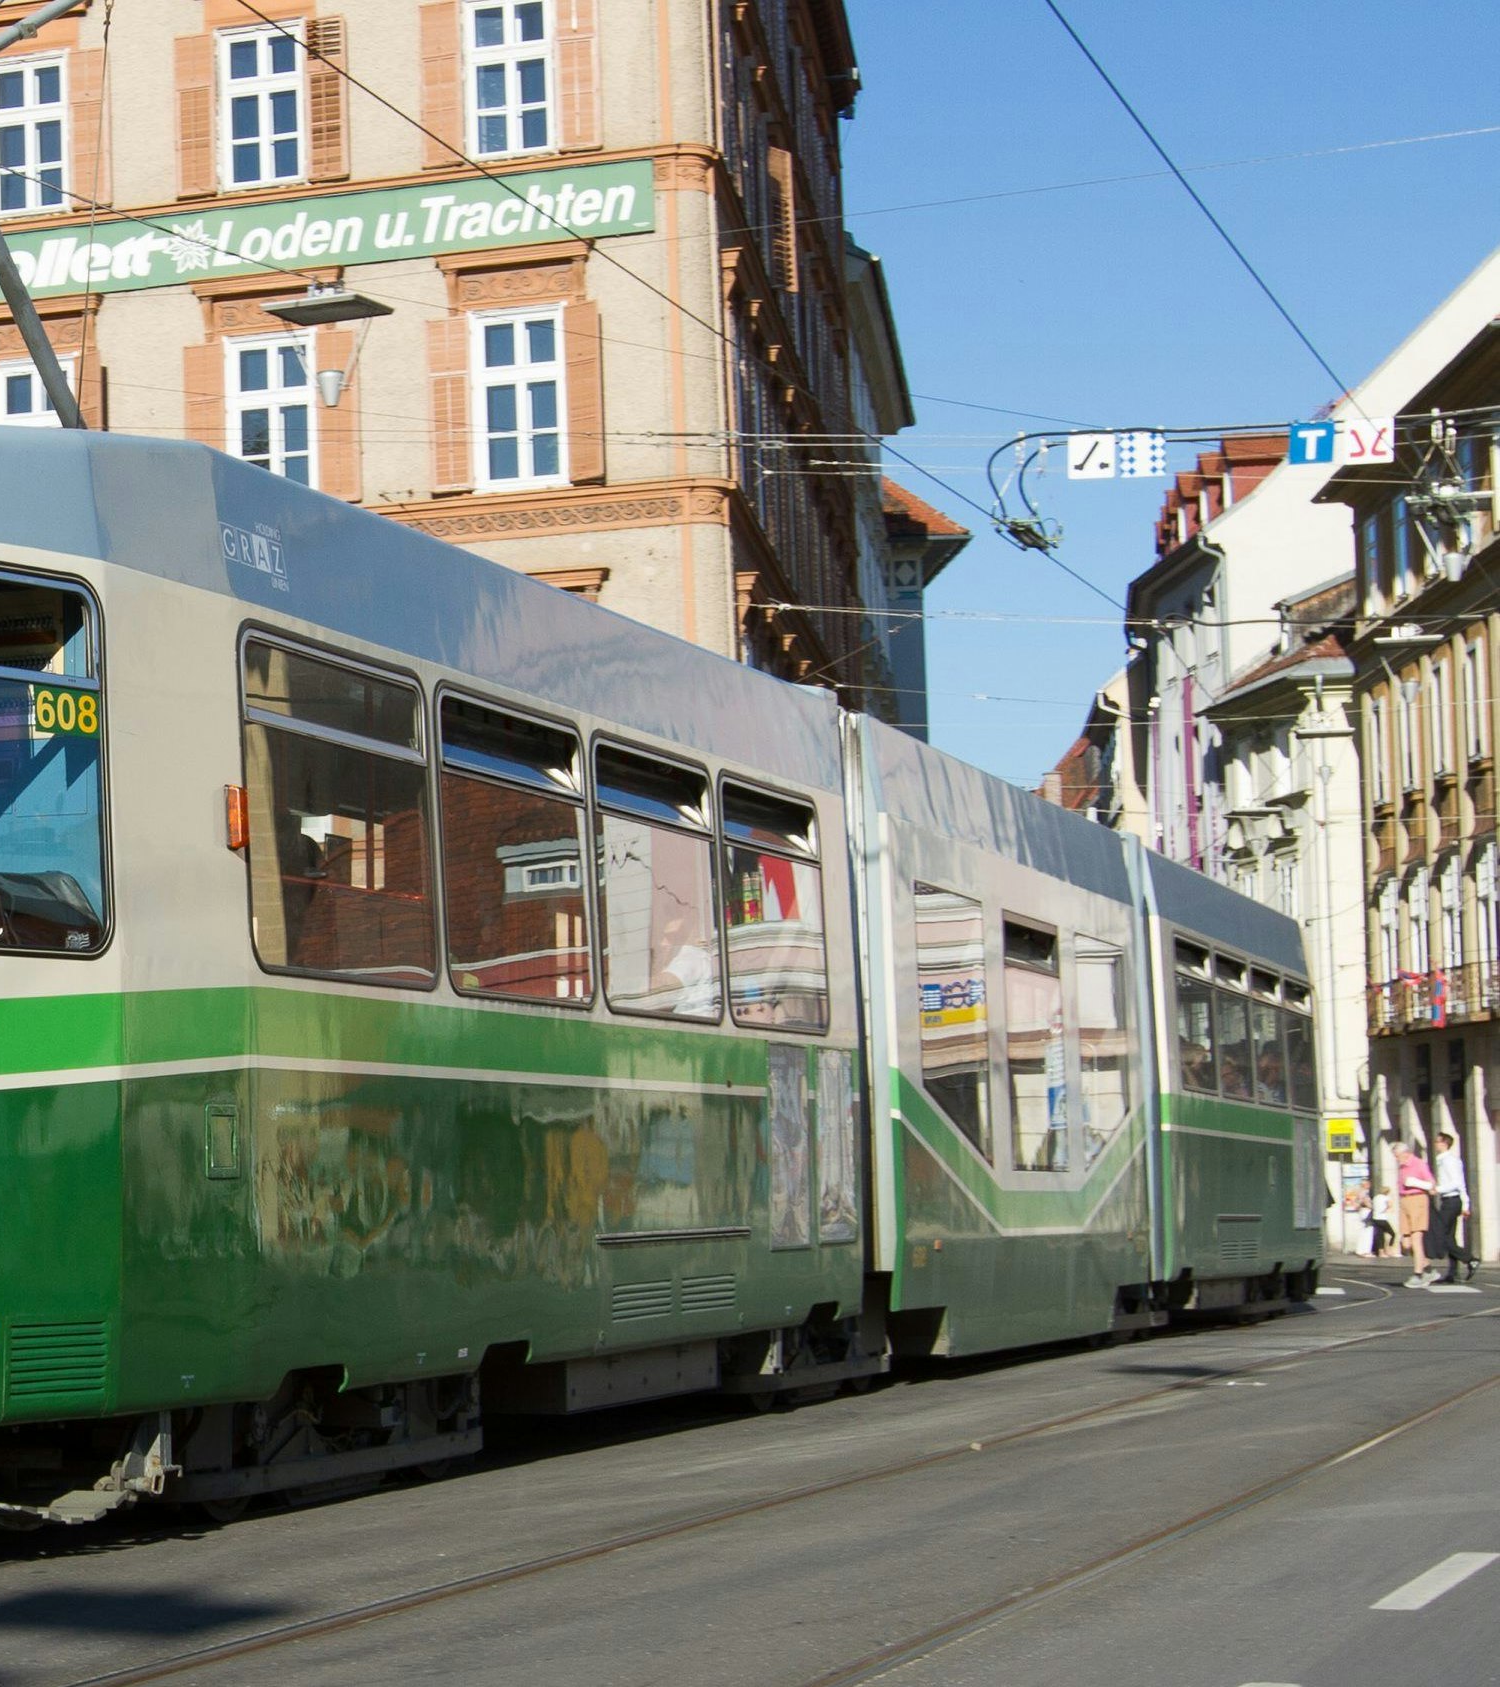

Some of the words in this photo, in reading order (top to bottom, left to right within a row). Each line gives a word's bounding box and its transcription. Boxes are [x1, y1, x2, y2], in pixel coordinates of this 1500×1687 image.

[213, 211, 364, 266] Loden
[1297, 429, 1327, 461] T
[222, 528, 285, 574] GRAZ
[36, 690, 98, 734] 608
